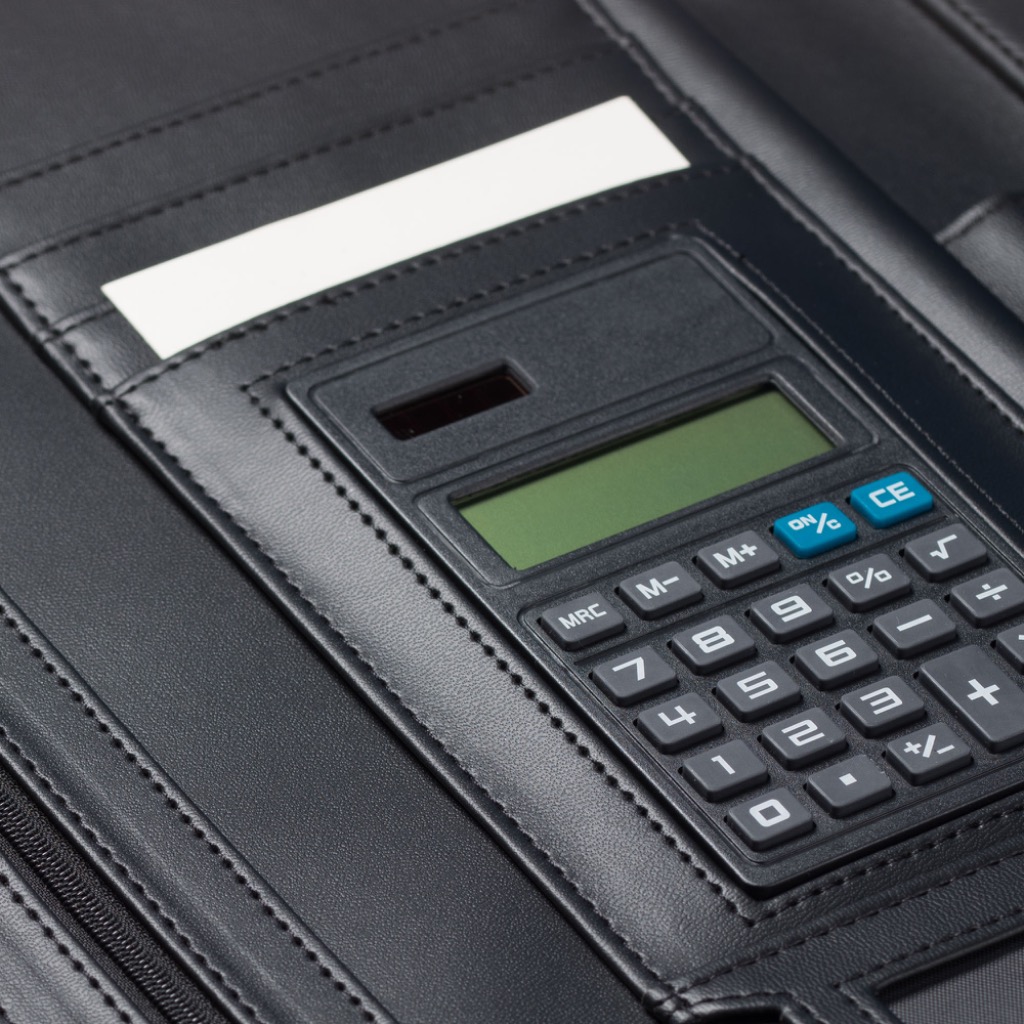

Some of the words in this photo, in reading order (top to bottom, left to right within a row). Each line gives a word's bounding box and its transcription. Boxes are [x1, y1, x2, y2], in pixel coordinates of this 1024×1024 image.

[870, 482, 914, 507] CE
[712, 543, 757, 569] M+
[636, 575, 680, 600] M-
[845, 567, 893, 589] %
[558, 602, 606, 630] MRC
[771, 595, 813, 622] 9
[691, 625, 736, 653] 8
[815, 639, 857, 667] 6
[612, 656, 646, 682] 7
[736, 670, 779, 700] 5
[860, 687, 903, 715] 3
[657, 704, 697, 727] 4
[781, 719, 825, 747] 2
[710, 754, 736, 775] 1
[749, 798, 791, 828] 0
